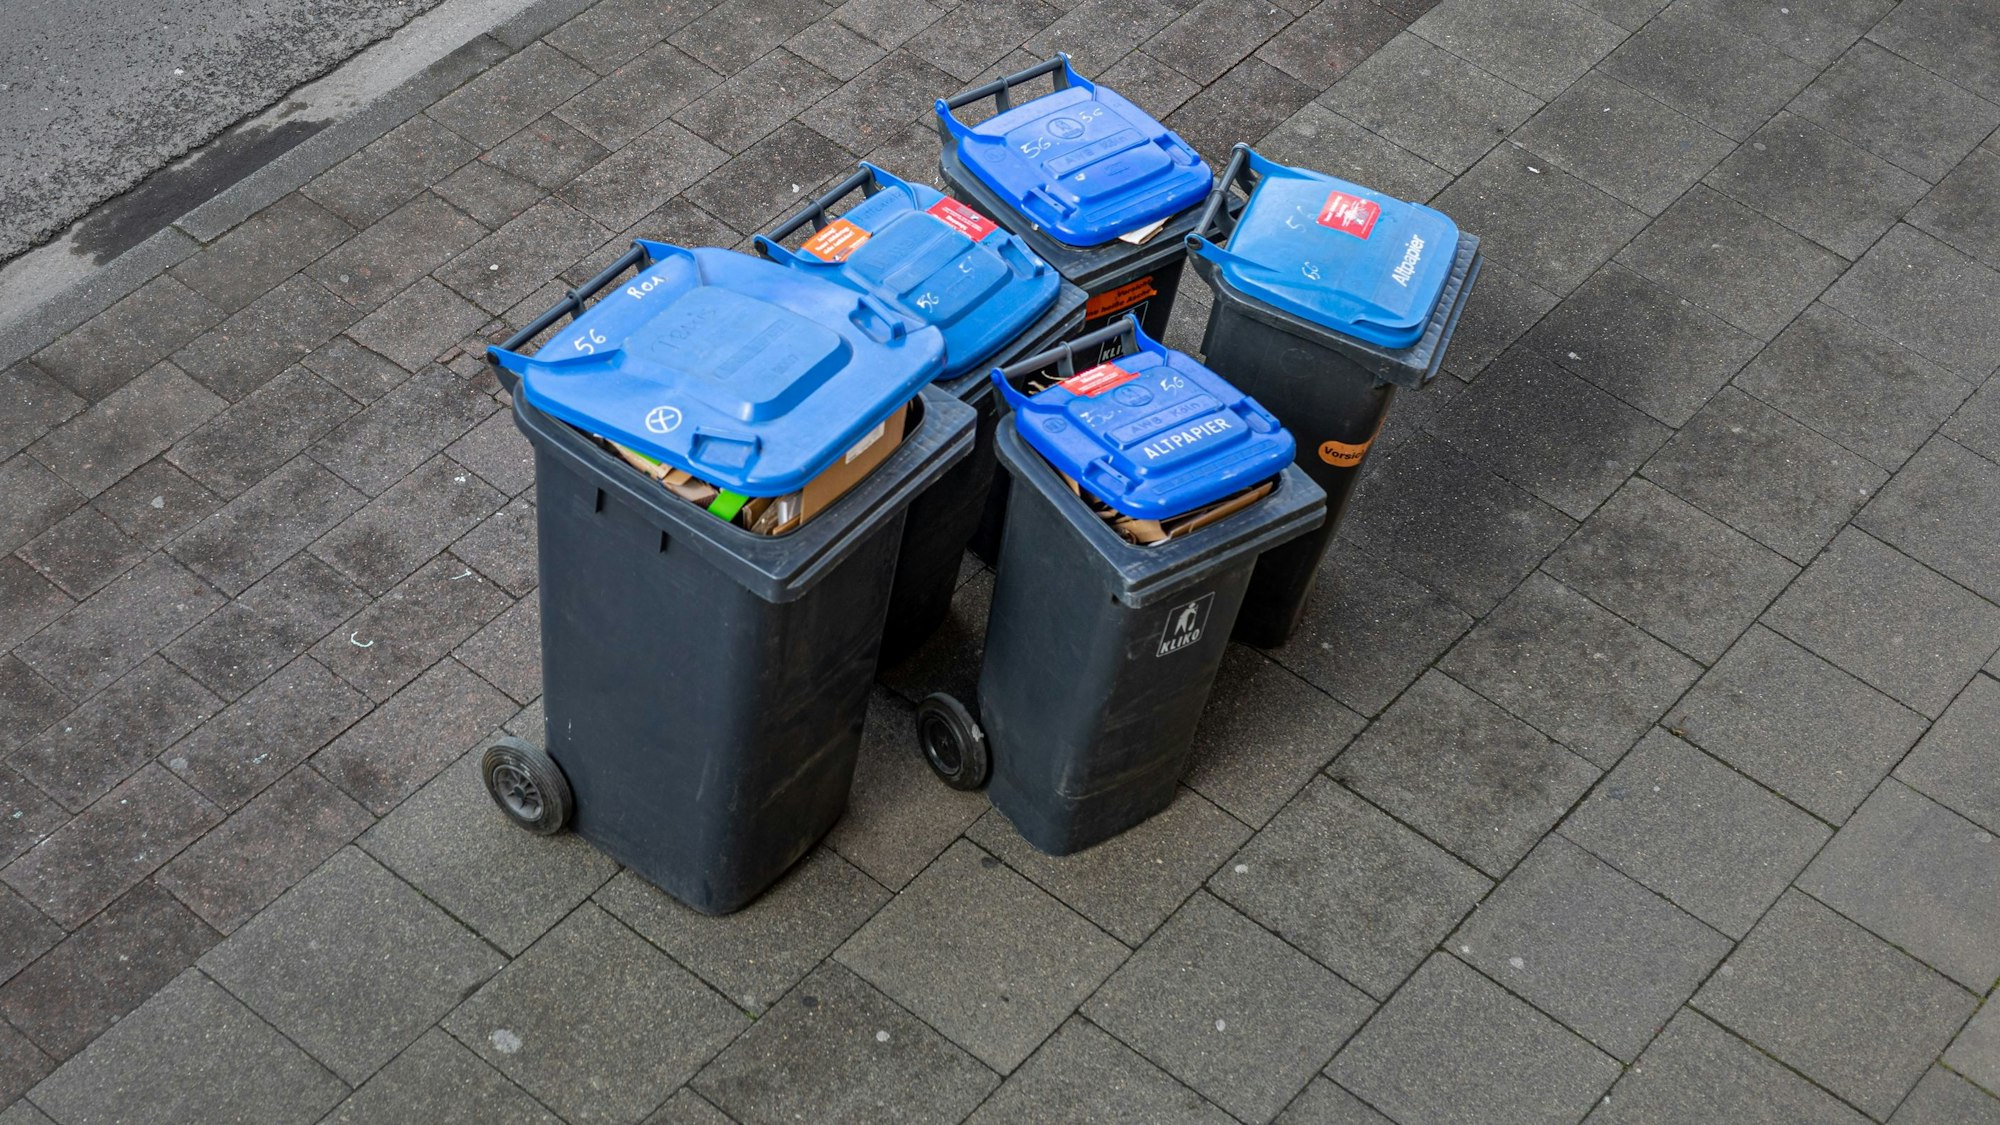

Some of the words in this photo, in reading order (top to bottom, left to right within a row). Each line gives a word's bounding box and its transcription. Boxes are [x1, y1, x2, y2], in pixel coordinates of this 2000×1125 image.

[1391, 234, 1425, 287] Altpapier
[574, 328, 606, 355] 56
[1102, 344, 1122, 361] KLI
[1143, 417, 1231, 461] ALTPAPIER
[1324, 446, 1364, 460] Vorsic
[1160, 628, 1200, 654] KLIKO
